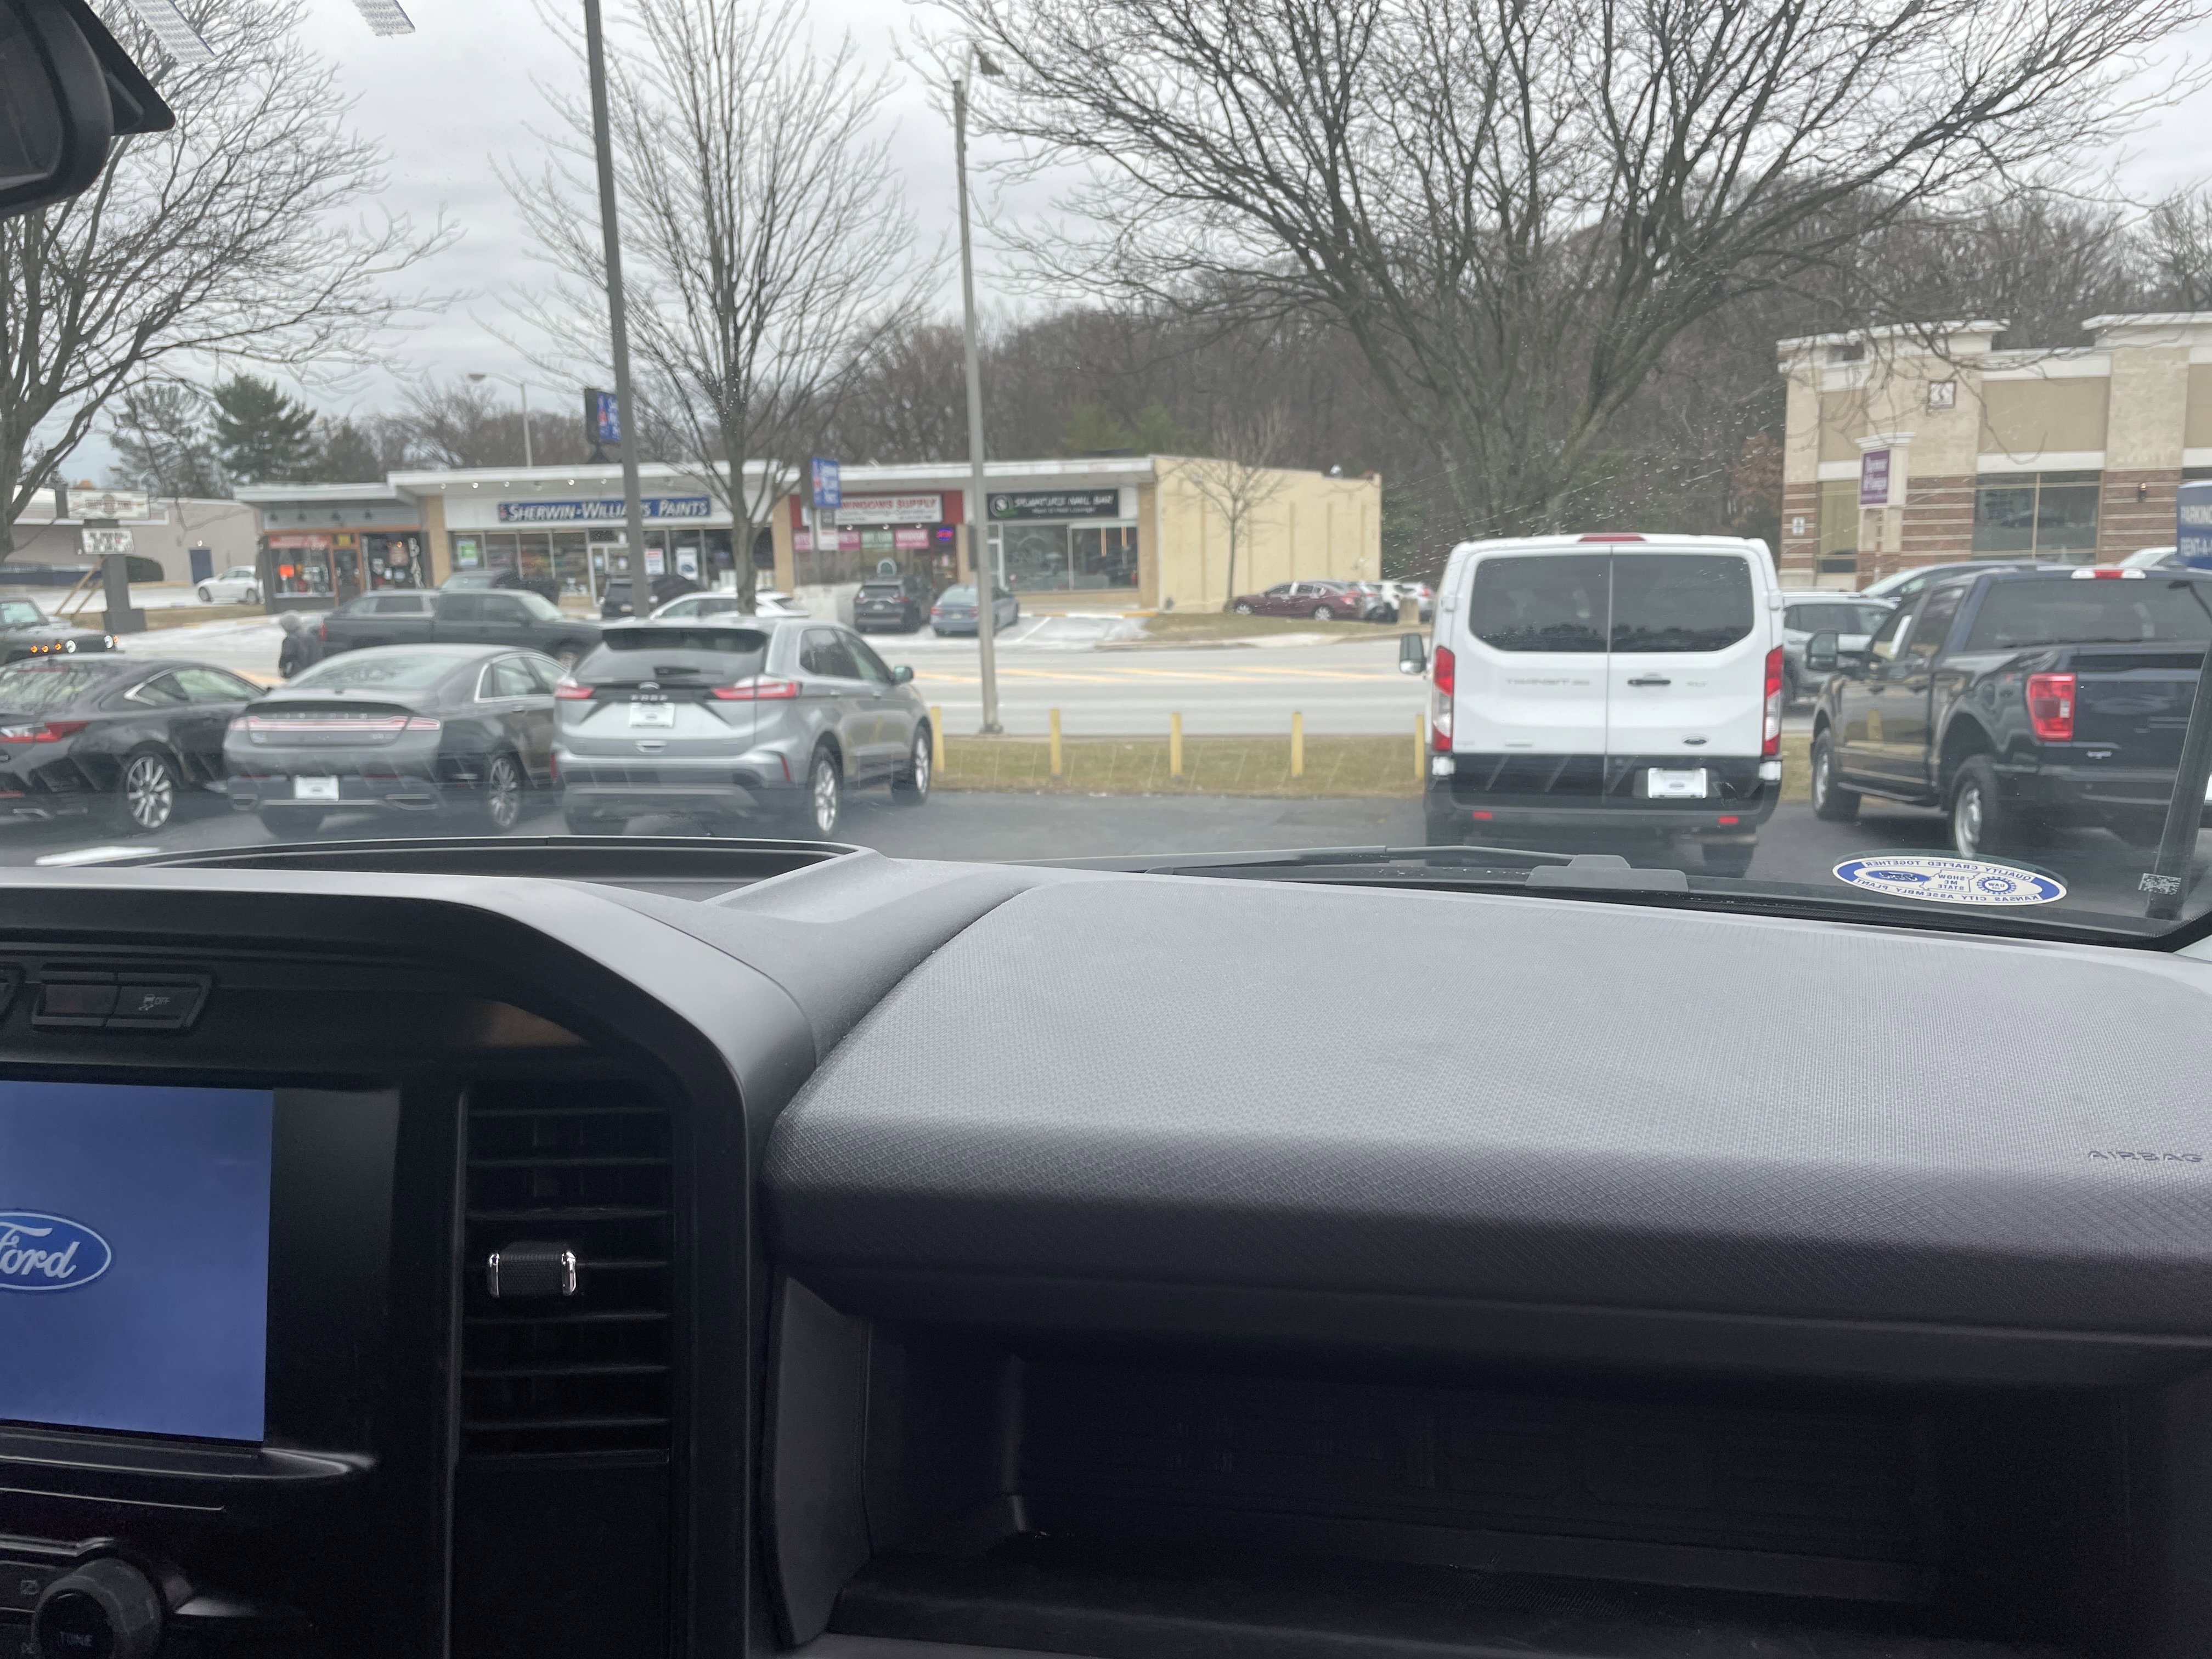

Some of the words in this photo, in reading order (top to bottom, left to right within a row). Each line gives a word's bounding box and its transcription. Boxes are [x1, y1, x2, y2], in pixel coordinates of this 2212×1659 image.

[508, 501, 651, 521] SHERWIN-WILLIAS
[658, 499, 708, 517] PAINTS
[155, 996, 171, 1005] OFF
[2088, 1150, 2203, 1163] AIRBAG
